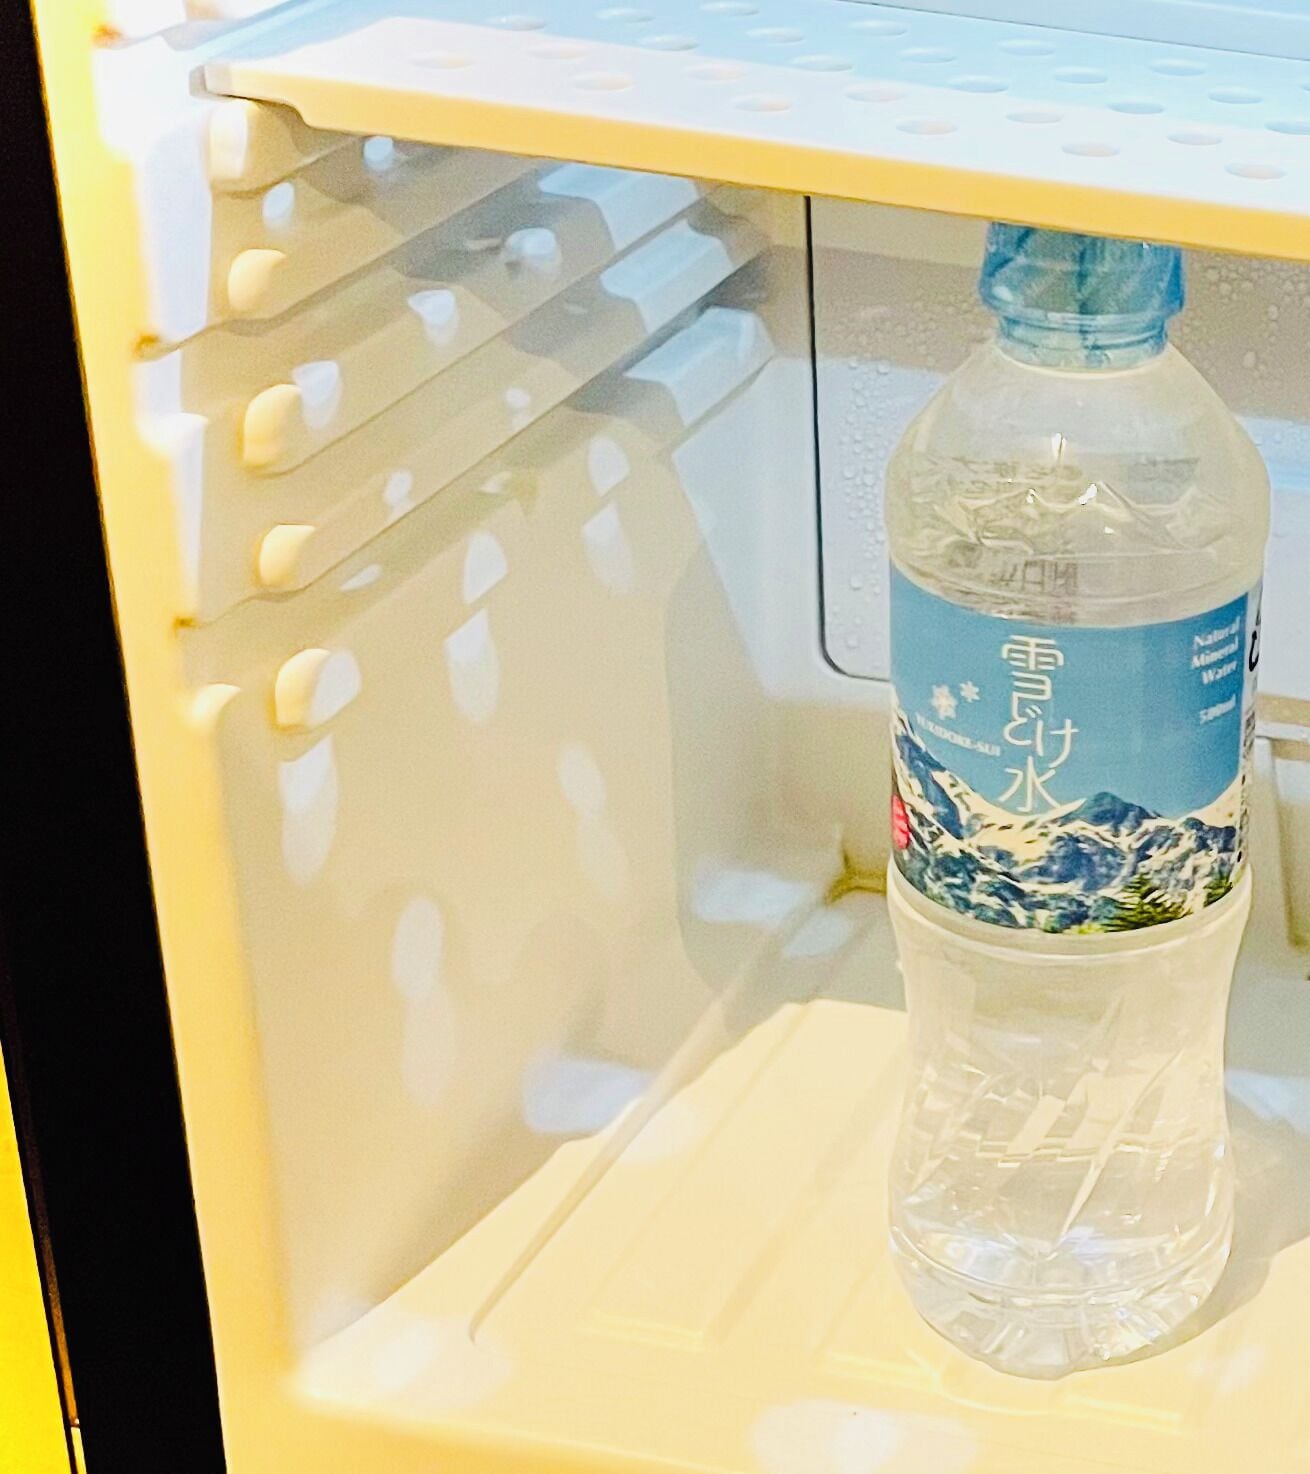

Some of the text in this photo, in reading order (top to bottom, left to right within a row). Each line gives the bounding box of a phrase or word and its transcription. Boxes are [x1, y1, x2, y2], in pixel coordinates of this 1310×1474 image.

[1193, 615, 1240, 650] Natural
[1191, 634, 1238, 670] Mineral
[1202, 661, 1237, 684] Water
[998, 634, 1079, 812] 雪どけ水
